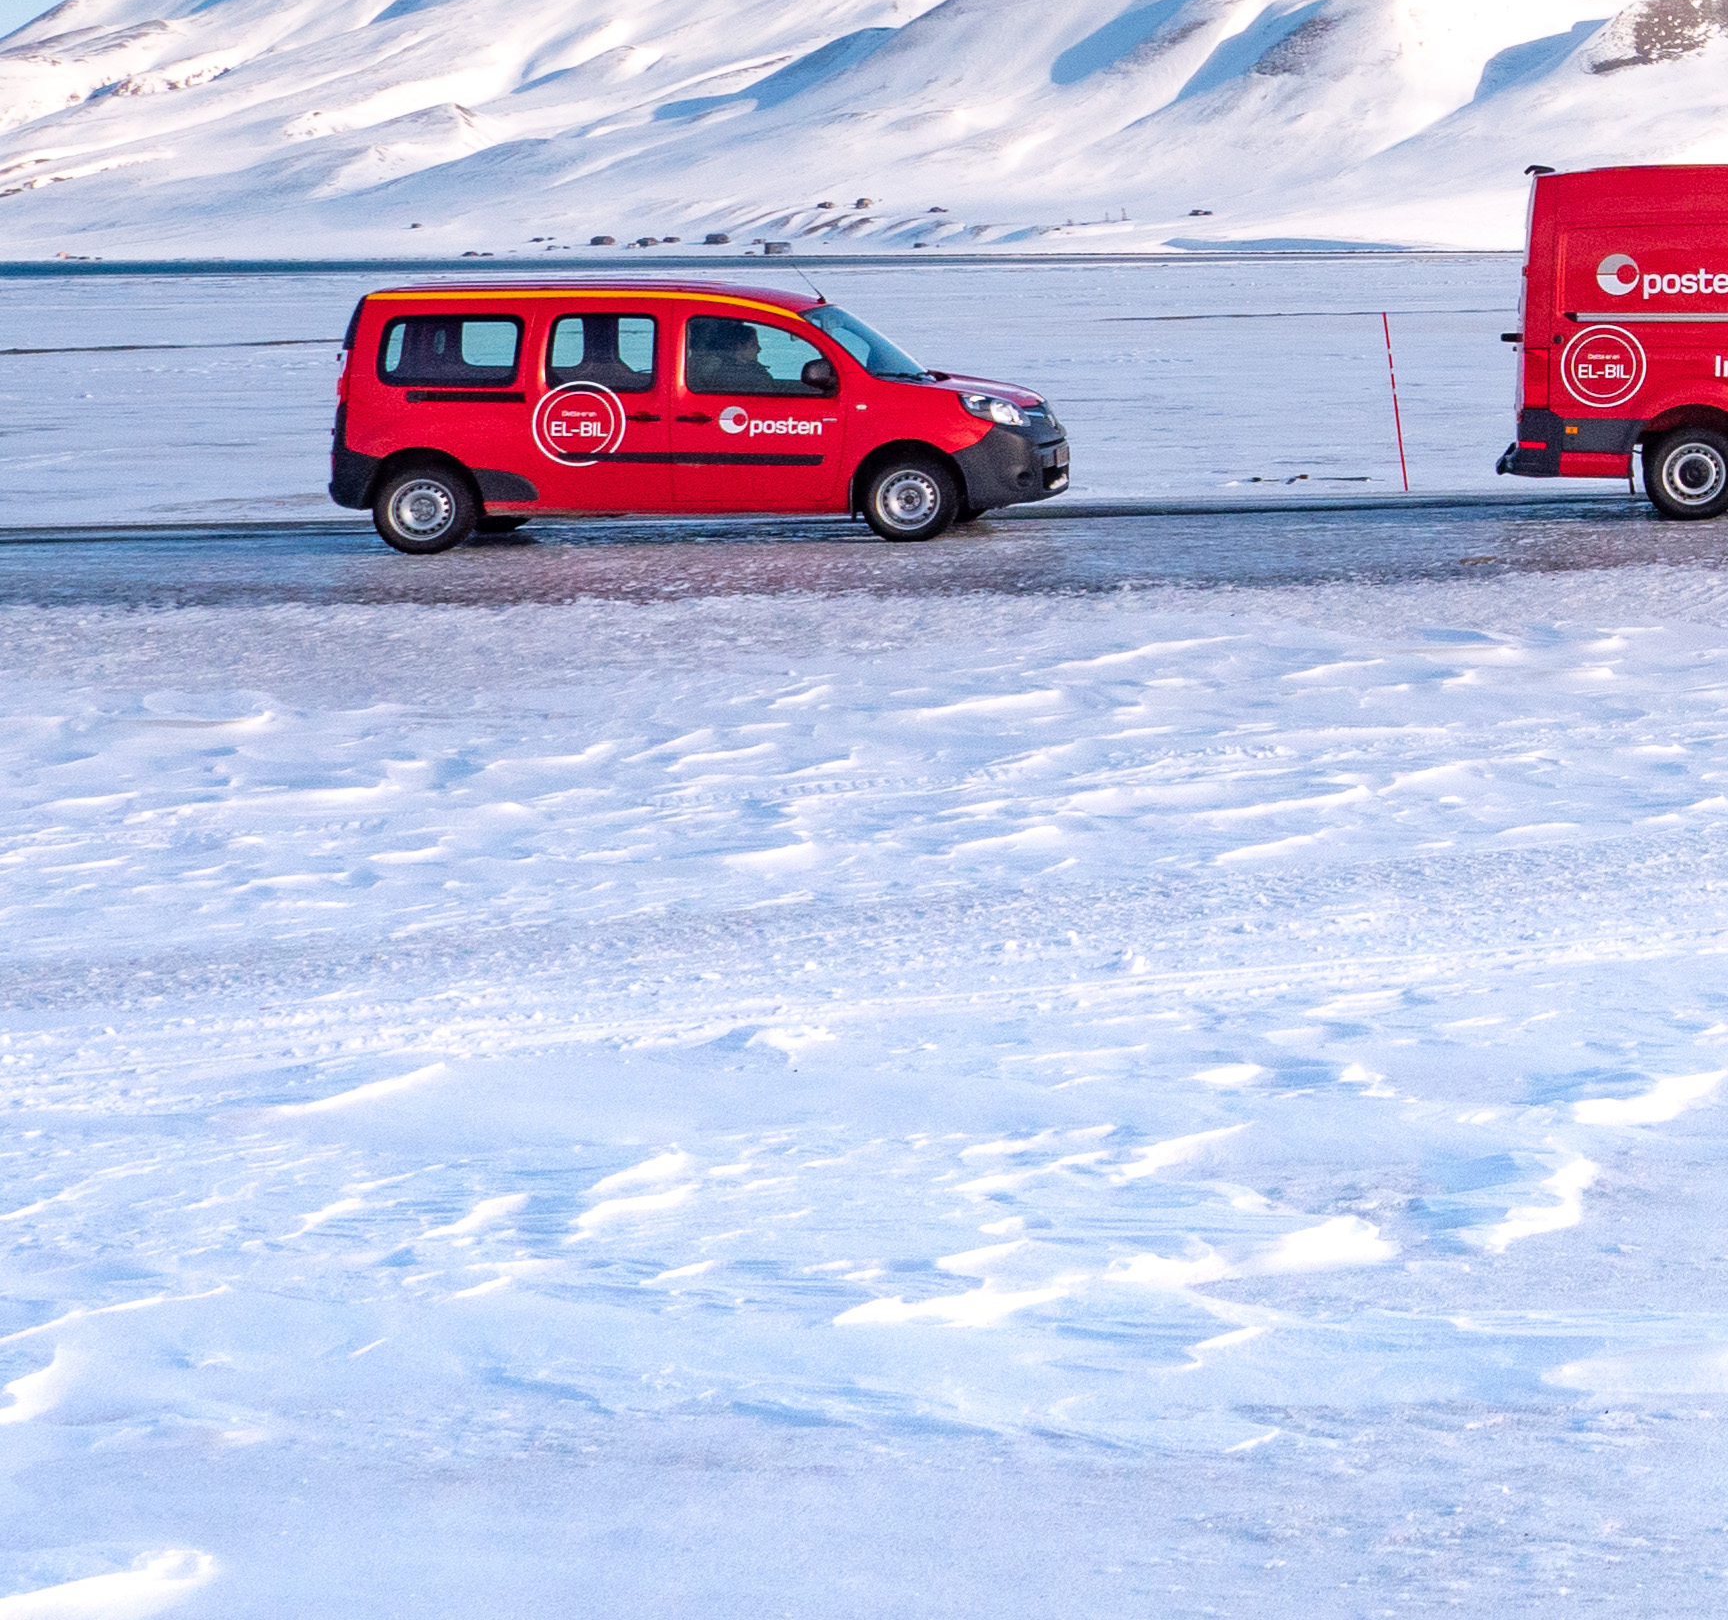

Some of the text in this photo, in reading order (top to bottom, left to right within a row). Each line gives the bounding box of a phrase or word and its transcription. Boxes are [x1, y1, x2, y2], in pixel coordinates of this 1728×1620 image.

[1578, 364, 1631, 379] EL-BIL
[551, 421, 608, 437] EL-BIL
[749, 416, 823, 437] posten
